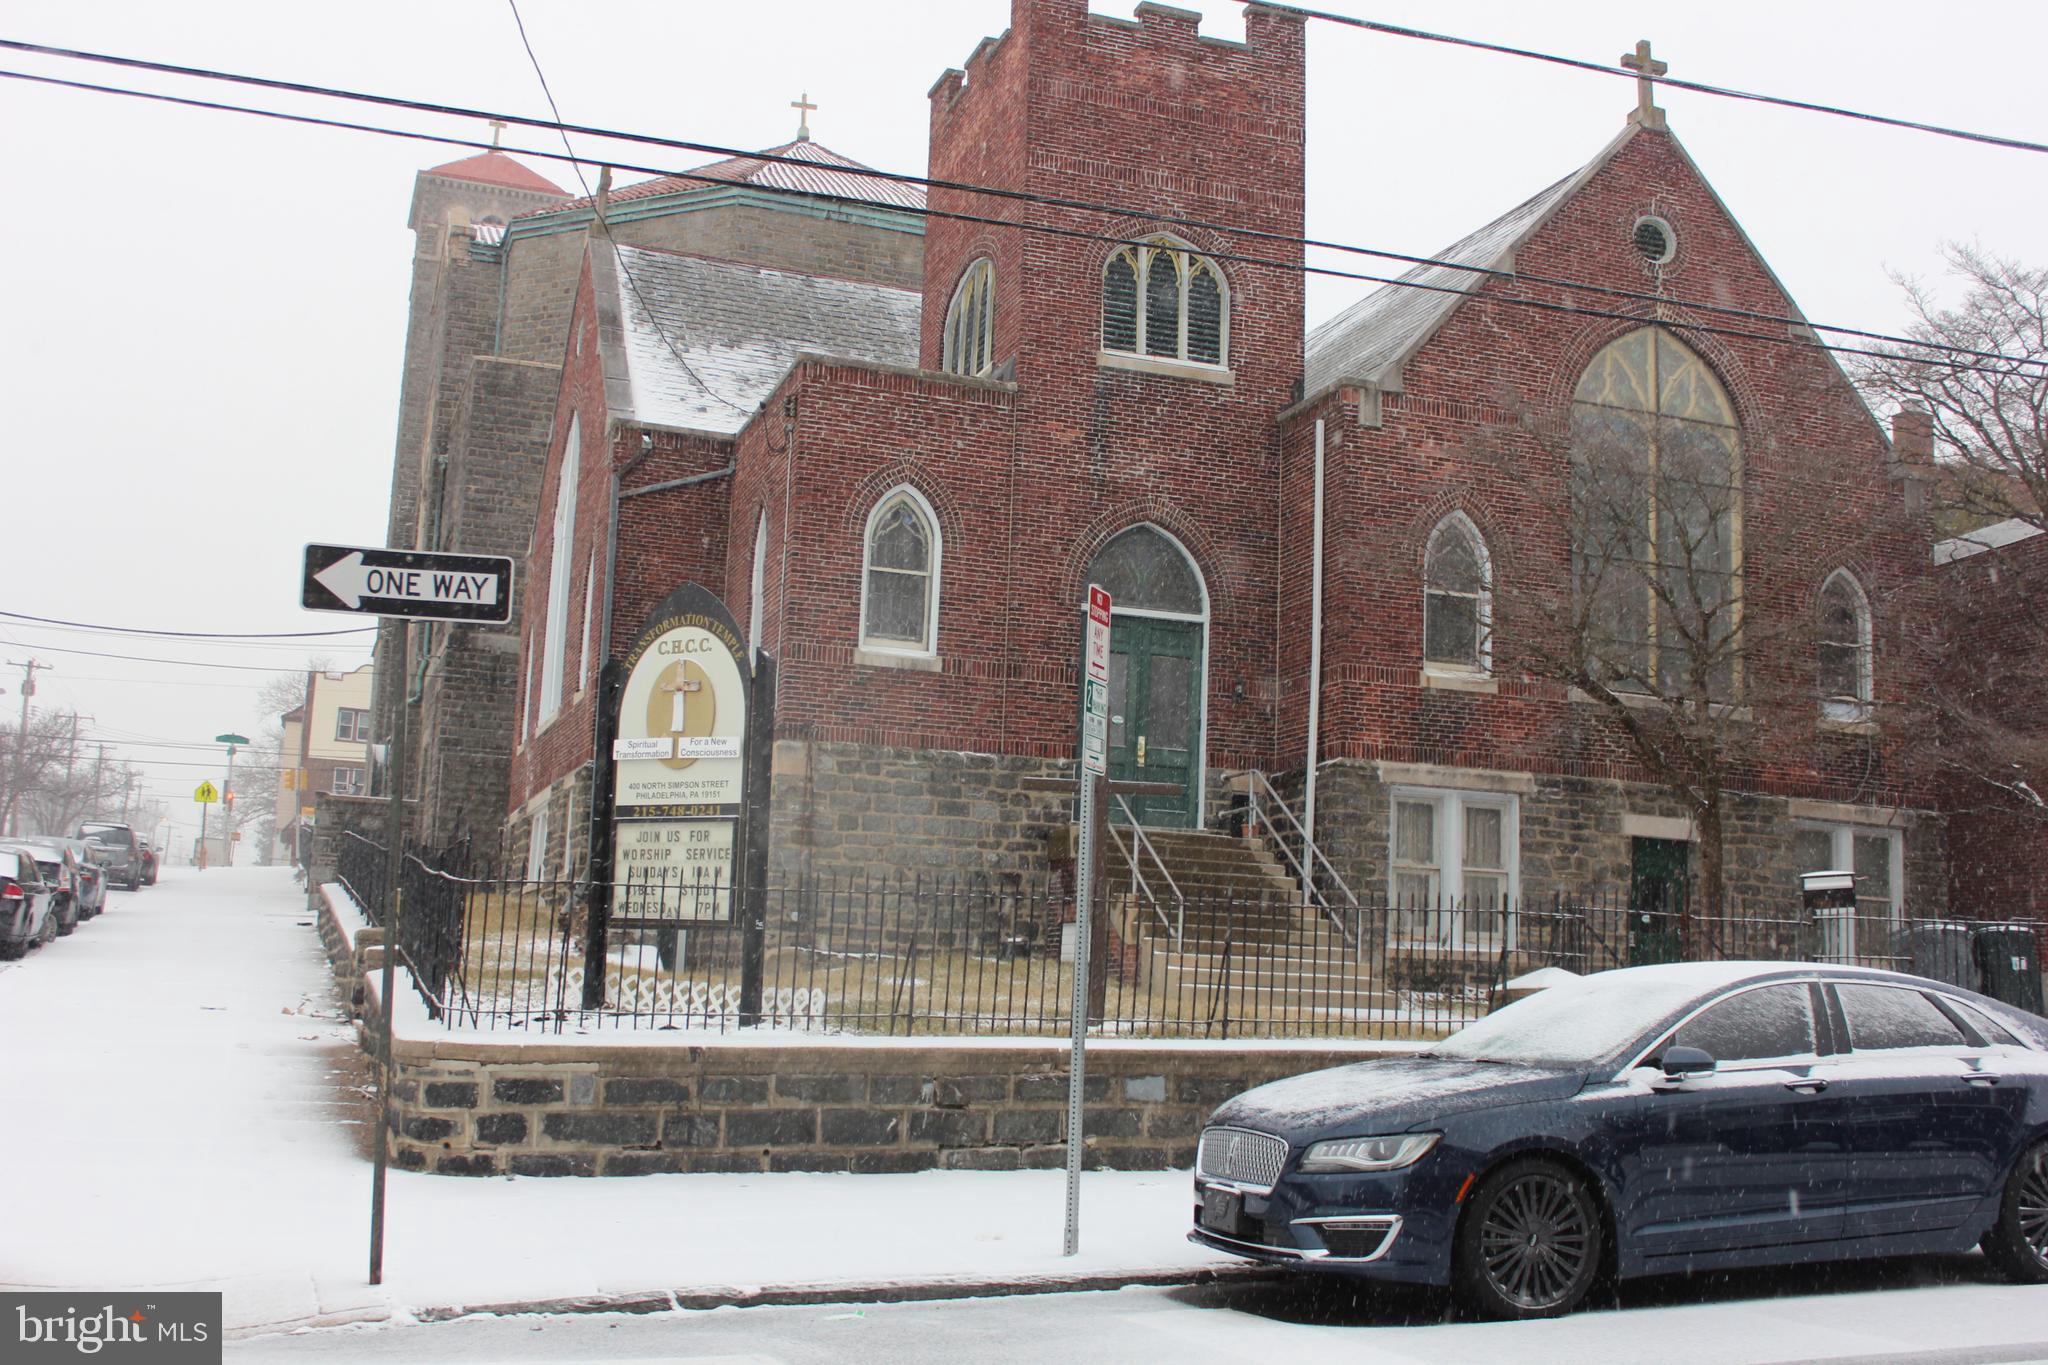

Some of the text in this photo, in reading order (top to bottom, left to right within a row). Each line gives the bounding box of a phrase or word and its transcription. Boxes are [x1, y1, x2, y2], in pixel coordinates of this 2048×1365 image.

[367, 569, 490, 601] ONE WAY
[623, 613, 745, 671] TRANSFORMATION TEMPLE
[627, 740, 658, 749] Spiritual
[689, 737, 703, 746] For
[710, 737, 728, 746] New
[615, 750, 670, 759] Transformation
[680, 748, 738, 757] Consciousness
[628, 780, 729, 790] 400 NORTH SIMPSON STREET
[689, 790, 700, 799] PA
[701, 790, 721, 798] 19151
[633, 804, 721, 817] 215-748-0241
[636, 830, 710, 843] JOIN US FOR
[622, 847, 731, 860] WORSHIP SERVICE
[625, 884, 657, 896] IBLE
